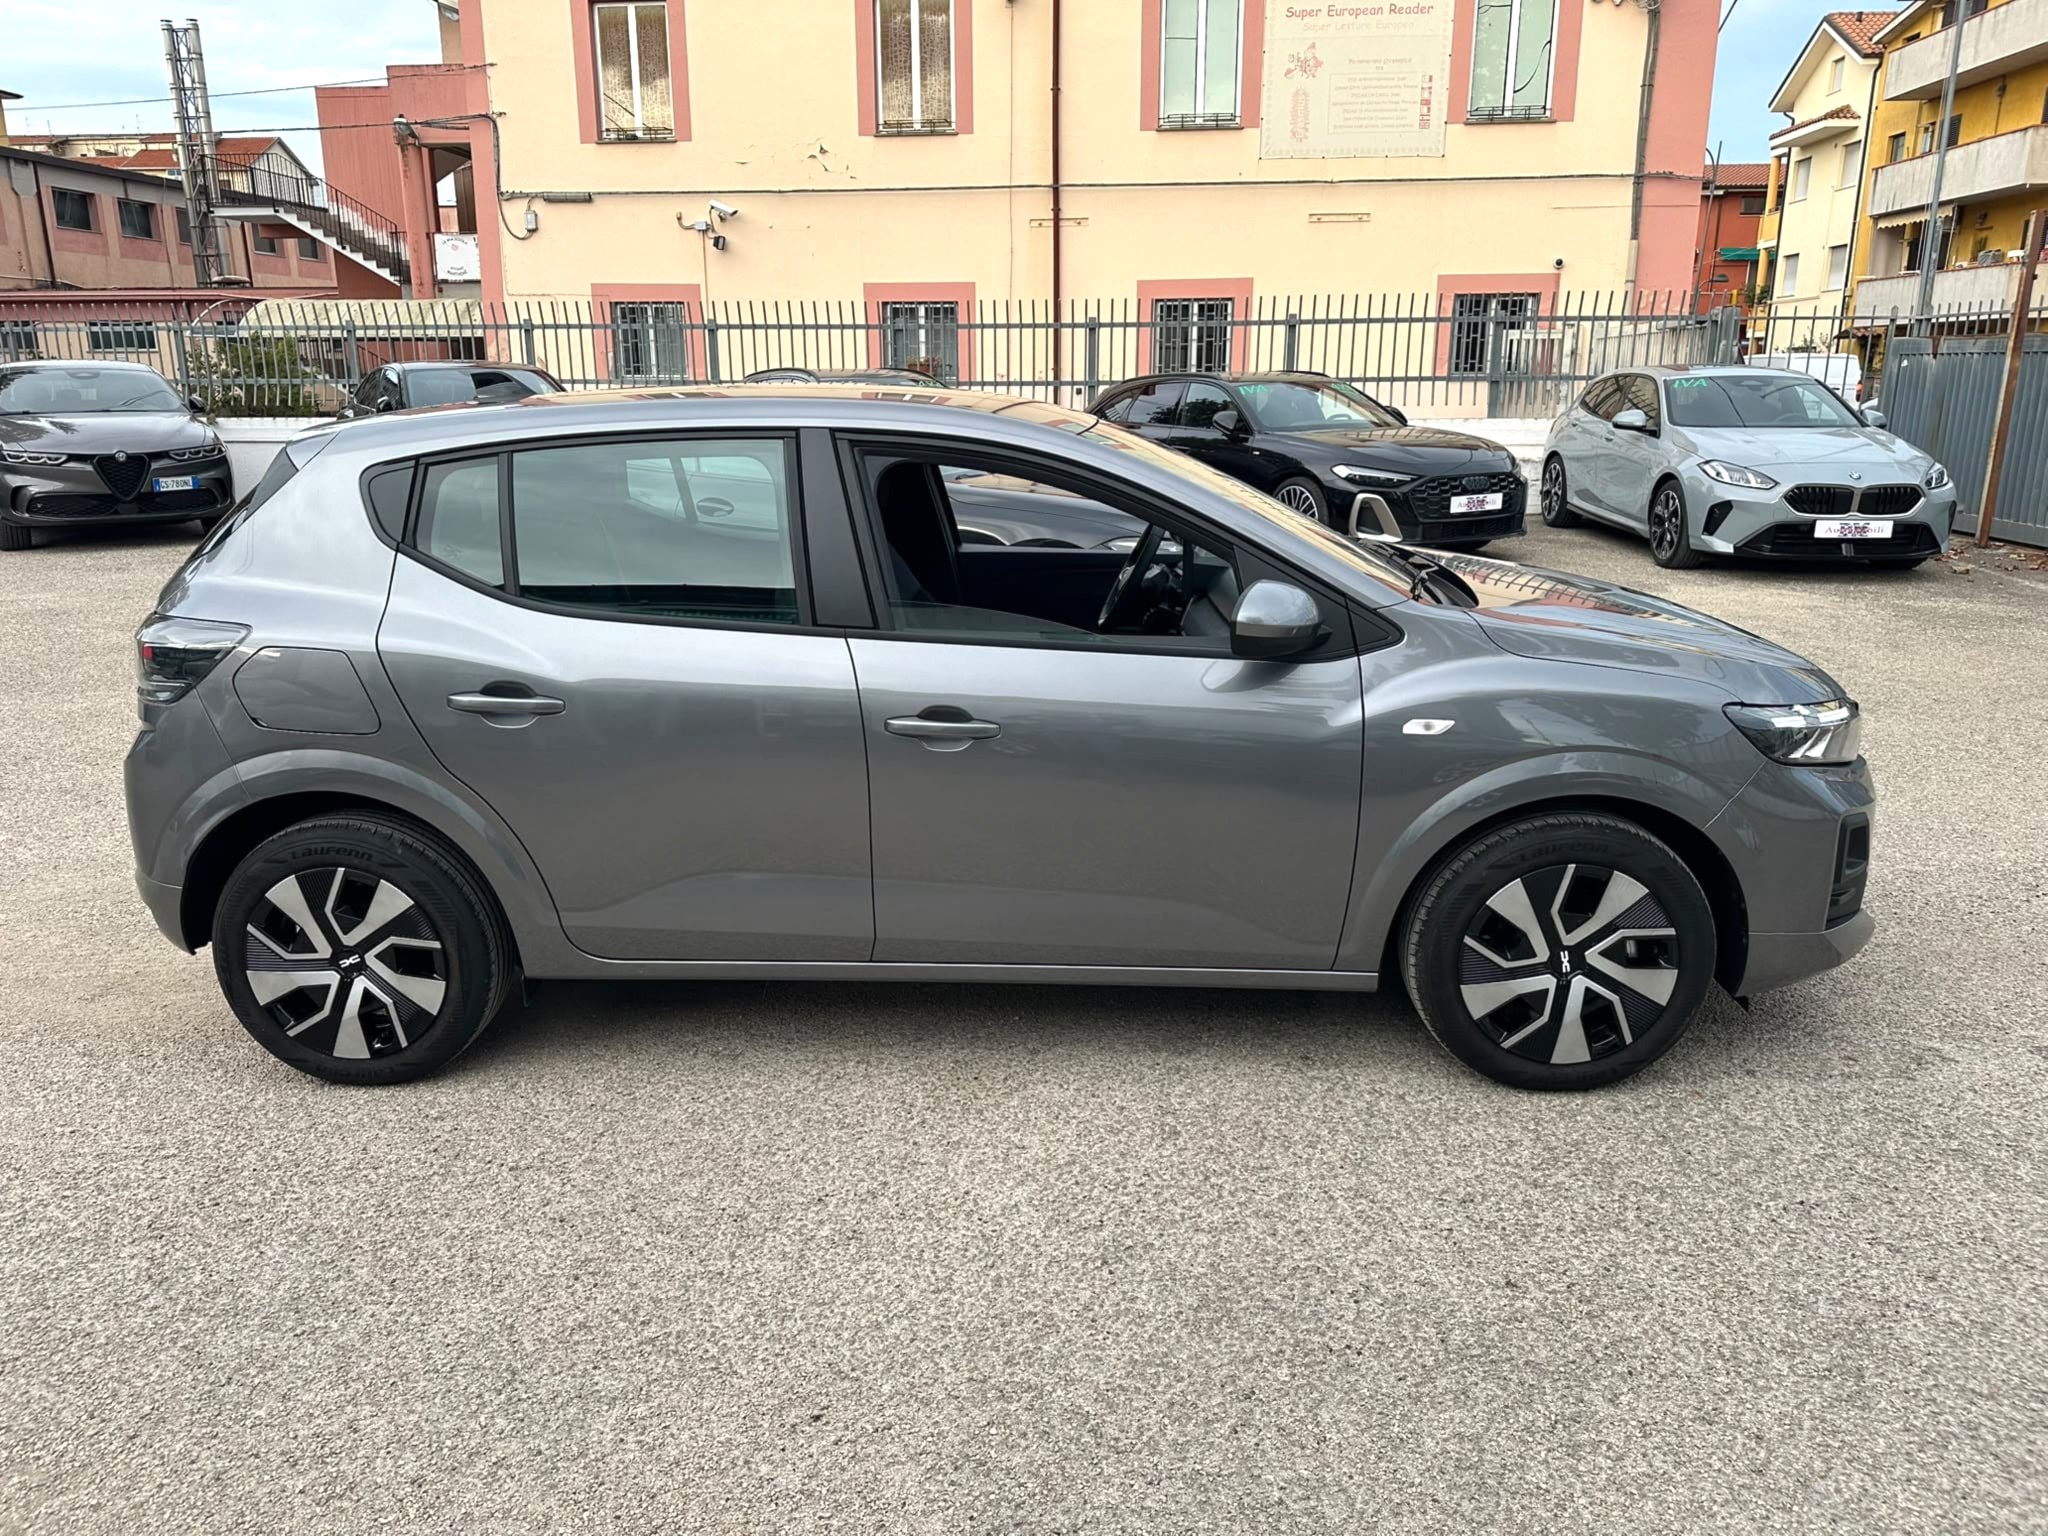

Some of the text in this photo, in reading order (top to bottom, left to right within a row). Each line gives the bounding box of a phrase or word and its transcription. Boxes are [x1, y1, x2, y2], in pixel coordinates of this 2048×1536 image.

[1285, 2, 1434, 20] Super European Reader
[1673, 378, 1708, 388] IVA
